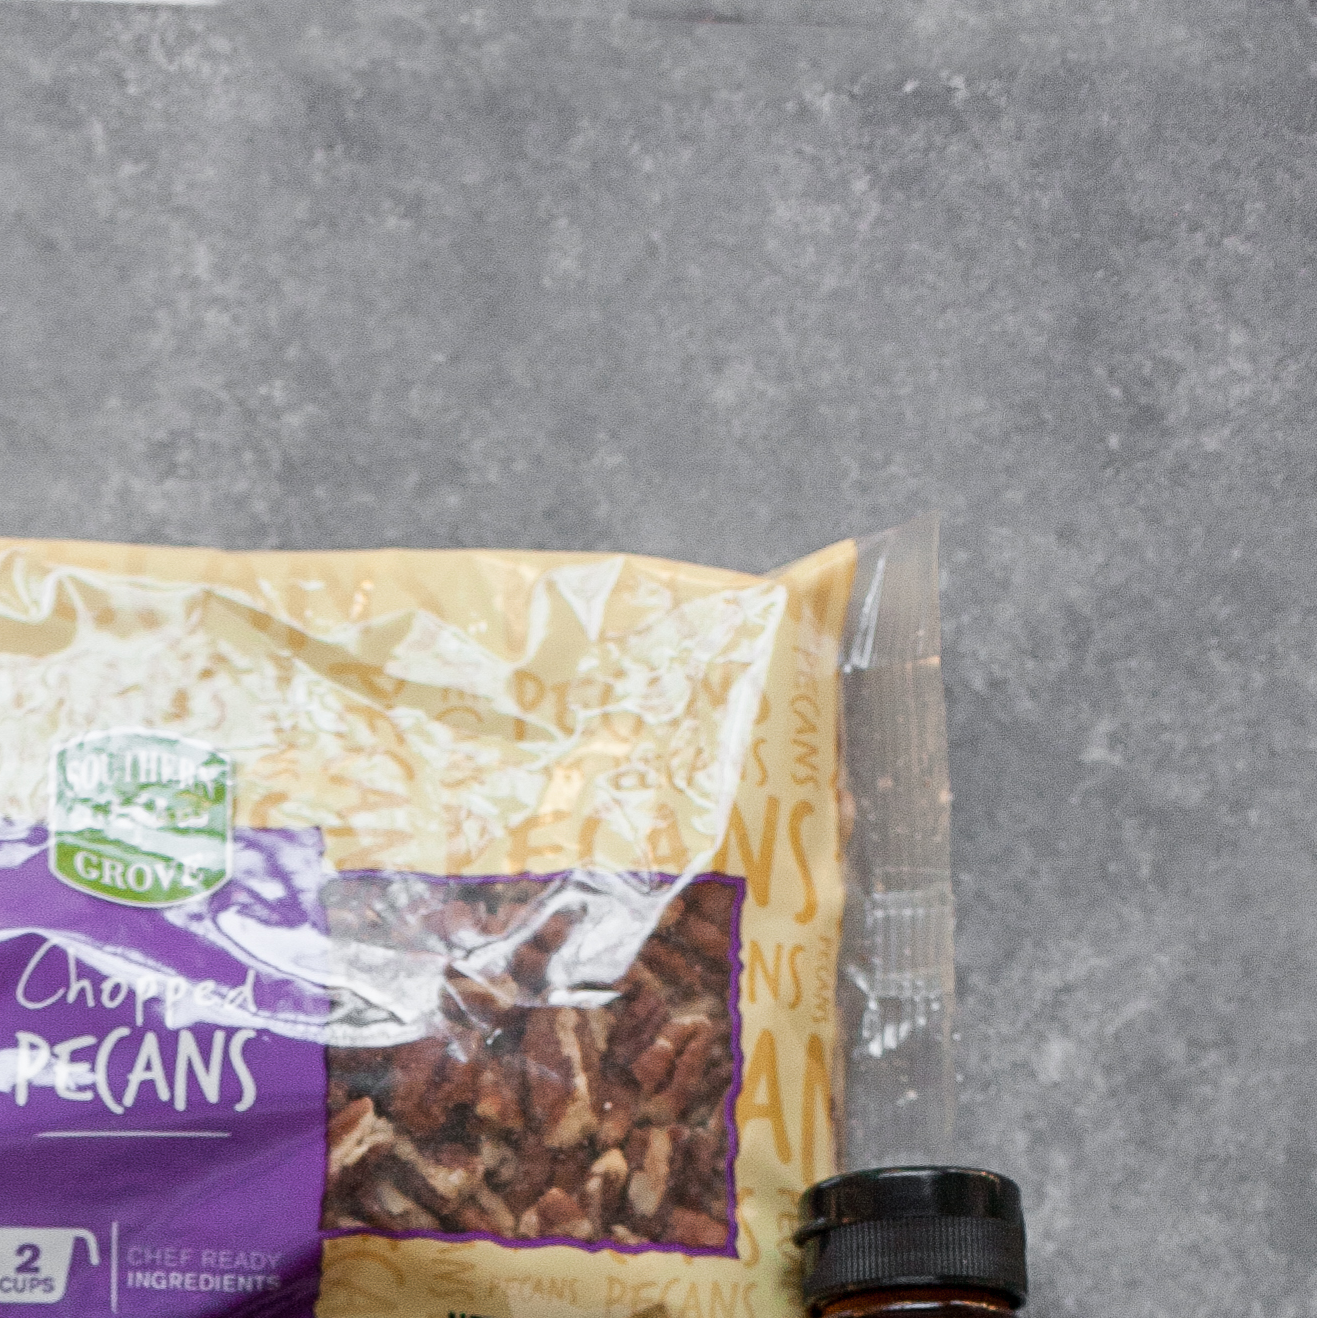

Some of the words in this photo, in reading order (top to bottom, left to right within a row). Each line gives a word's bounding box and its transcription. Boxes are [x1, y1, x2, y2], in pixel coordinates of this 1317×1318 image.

[74, 850, 205, 892] GROVE
[16, 936, 257, 1027] Chopped
[13, 1027, 257, 1114] PECANS
[14, 1243, 40, 1273] 2
[127, 1246, 193, 1267] CHEF
[202, 1248, 280, 1269] READY
[126, 1270, 280, 1292] INGREDIENTS
